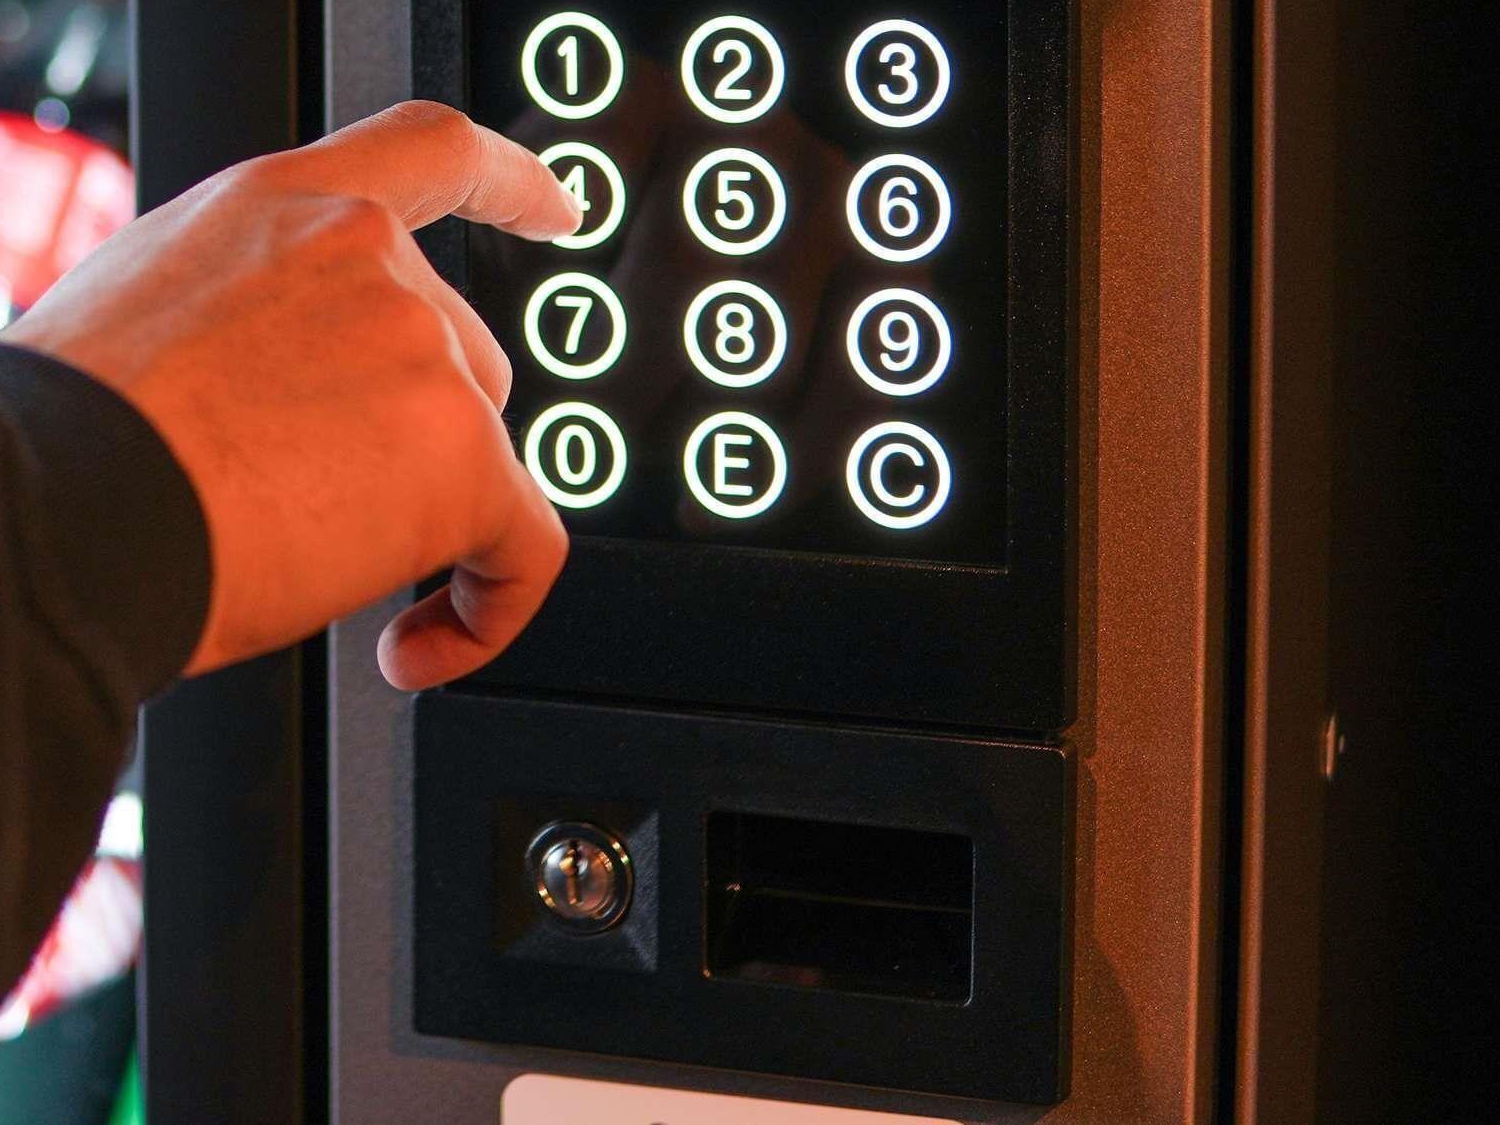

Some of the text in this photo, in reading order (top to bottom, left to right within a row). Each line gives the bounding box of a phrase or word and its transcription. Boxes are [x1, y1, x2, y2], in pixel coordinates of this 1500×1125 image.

[556, 35, 919, 105] 1 2 3
[561, 164, 920, 238] 4 5 6
[554, 295, 920, 372] 7 8 9
[554, 424, 926, 507] 0 E C
